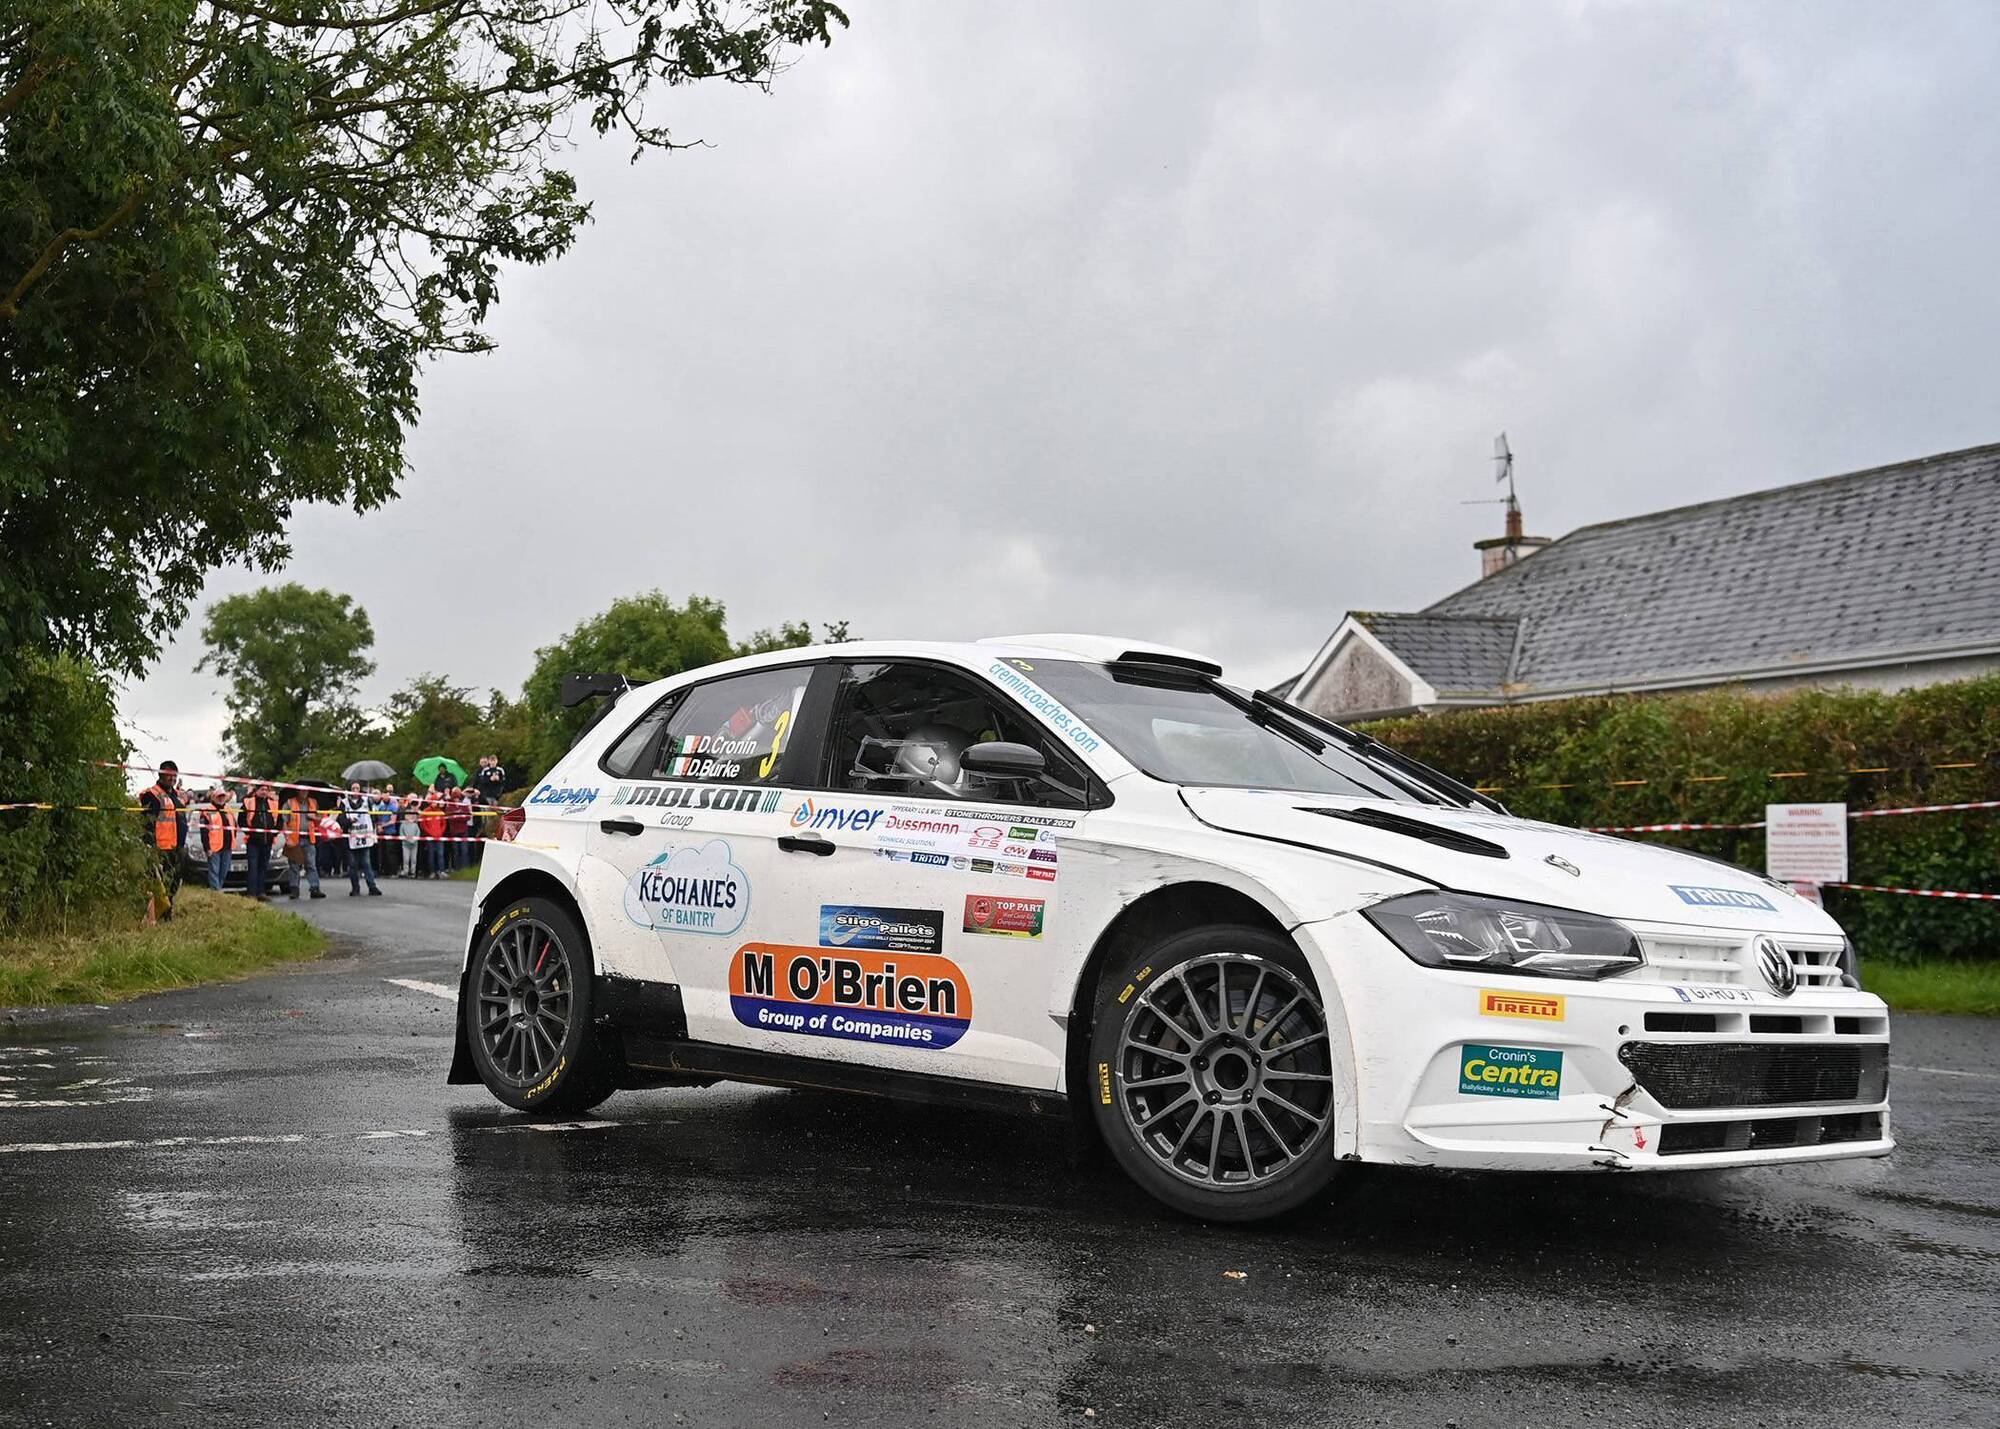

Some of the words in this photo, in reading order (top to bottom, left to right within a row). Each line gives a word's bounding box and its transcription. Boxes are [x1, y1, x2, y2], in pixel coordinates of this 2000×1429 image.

[988, 663, 1099, 753] cremincoaches.com
[697, 735, 757, 754] D.Cronin
[759, 711, 790, 778] 3
[687, 759, 740, 777] D.Burke
[660, 812, 694, 830] Group
[885, 815, 960, 835] Dussmann
[946, 809, 1021, 822] STONETHROWERS
[1022, 816, 1051, 825] RALLY
[1052, 820, 1074, 828] 2024
[914, 853, 946, 865] TRITON
[639, 872, 737, 909] KEOHANE'S
[1677, 887, 1770, 909] TRITON
[996, 901, 1016, 910] TOP
[1016, 903, 1043, 912] PART
[675, 909, 716, 927] BANTRY
[836, 915, 880, 927] Sligo
[880, 924, 934, 937] Pallets
[742, 951, 775, 997] M
[1486, 995, 1559, 1016] PIRELLI
[758, 1008, 804, 1030] Group
[809, 1014, 827, 1029] of
[832, 1015, 933, 1042] Companies
[1488, 1048, 1537, 1063] Cronin's
[1463, 1059, 1559, 1087] Centra
[1503, 1086, 1519, 1095] Leap
[1526, 1088, 1546, 1097] Union
[1546, 1089, 1558, 1097] hall
